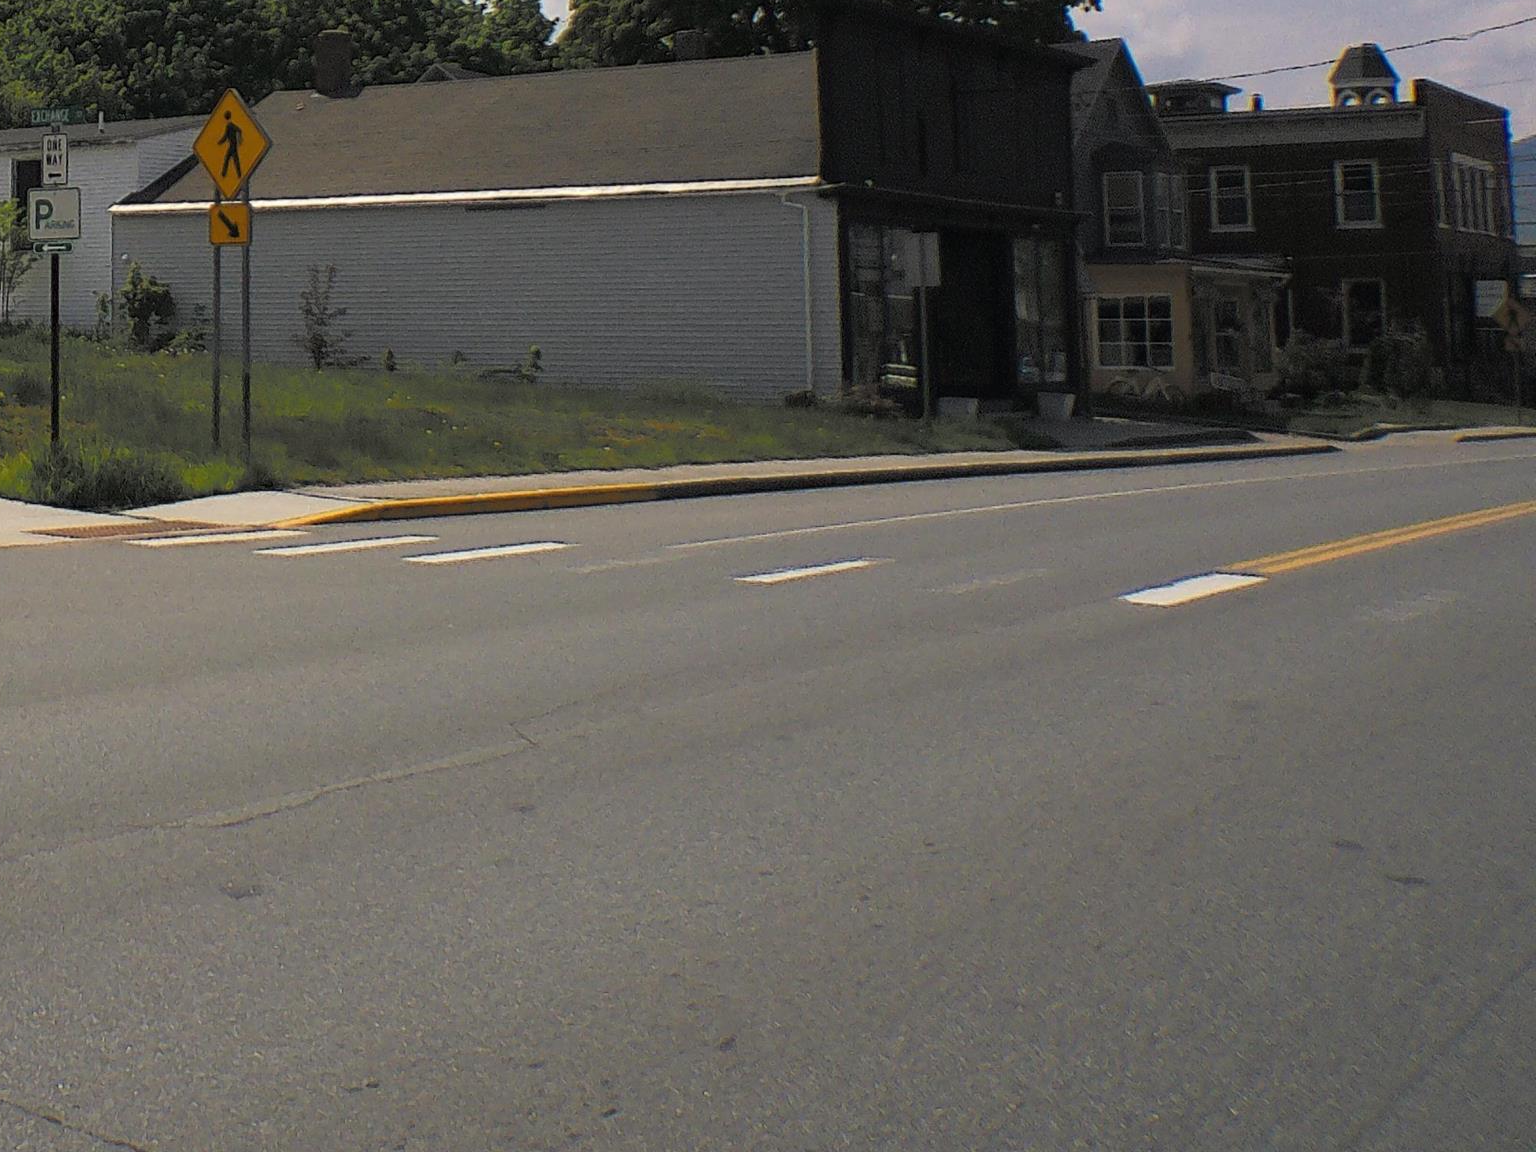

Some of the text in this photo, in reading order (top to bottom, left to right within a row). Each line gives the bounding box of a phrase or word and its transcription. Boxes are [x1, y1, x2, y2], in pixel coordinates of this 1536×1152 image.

[32, 109, 70, 123] EXCHANGE
[47, 139, 62, 151] ONE
[47, 154, 63, 166] WAY
